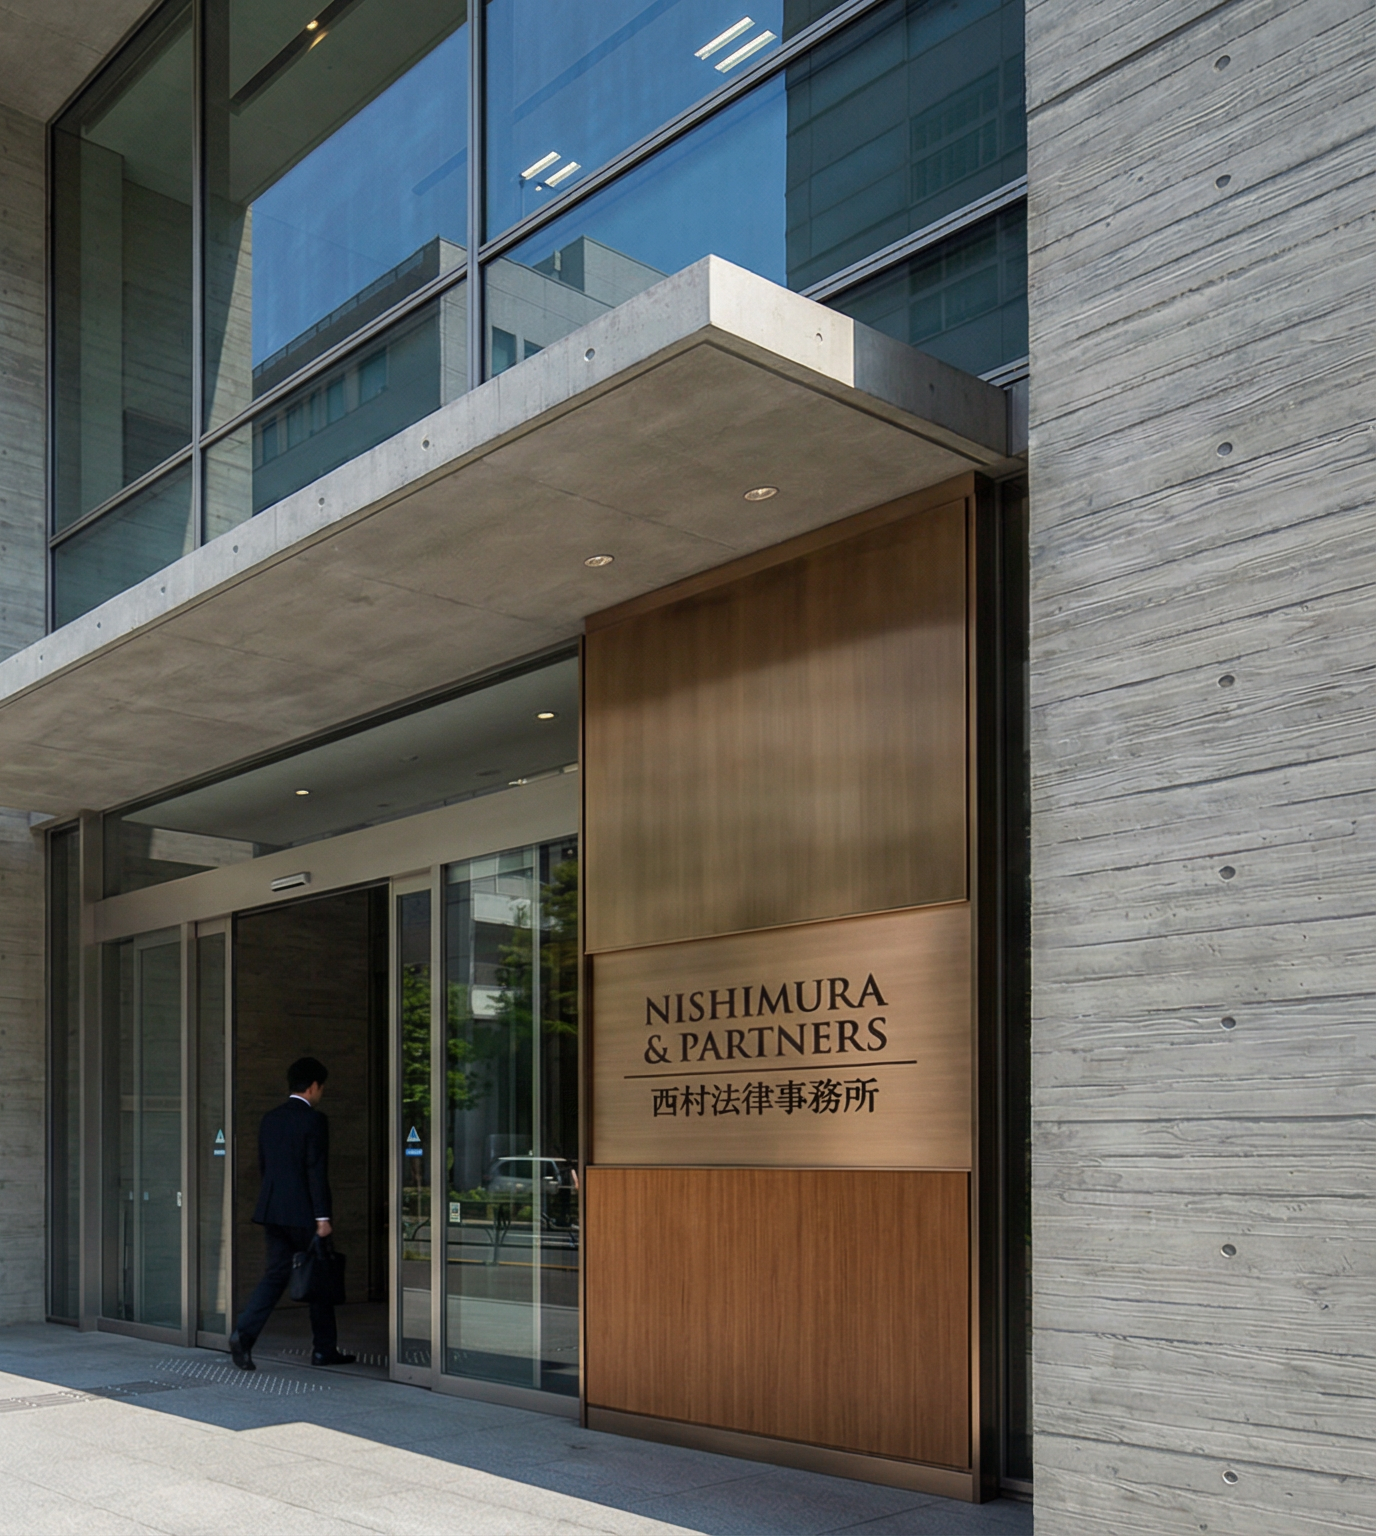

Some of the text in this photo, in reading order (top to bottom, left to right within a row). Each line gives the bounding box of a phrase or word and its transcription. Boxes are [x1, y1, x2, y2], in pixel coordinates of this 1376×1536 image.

[645, 973, 888, 1025] NISHIMURA
[644, 1017, 887, 1064] & PARTNERS
[651, 1078, 879, 1117] 西村法律事務所
